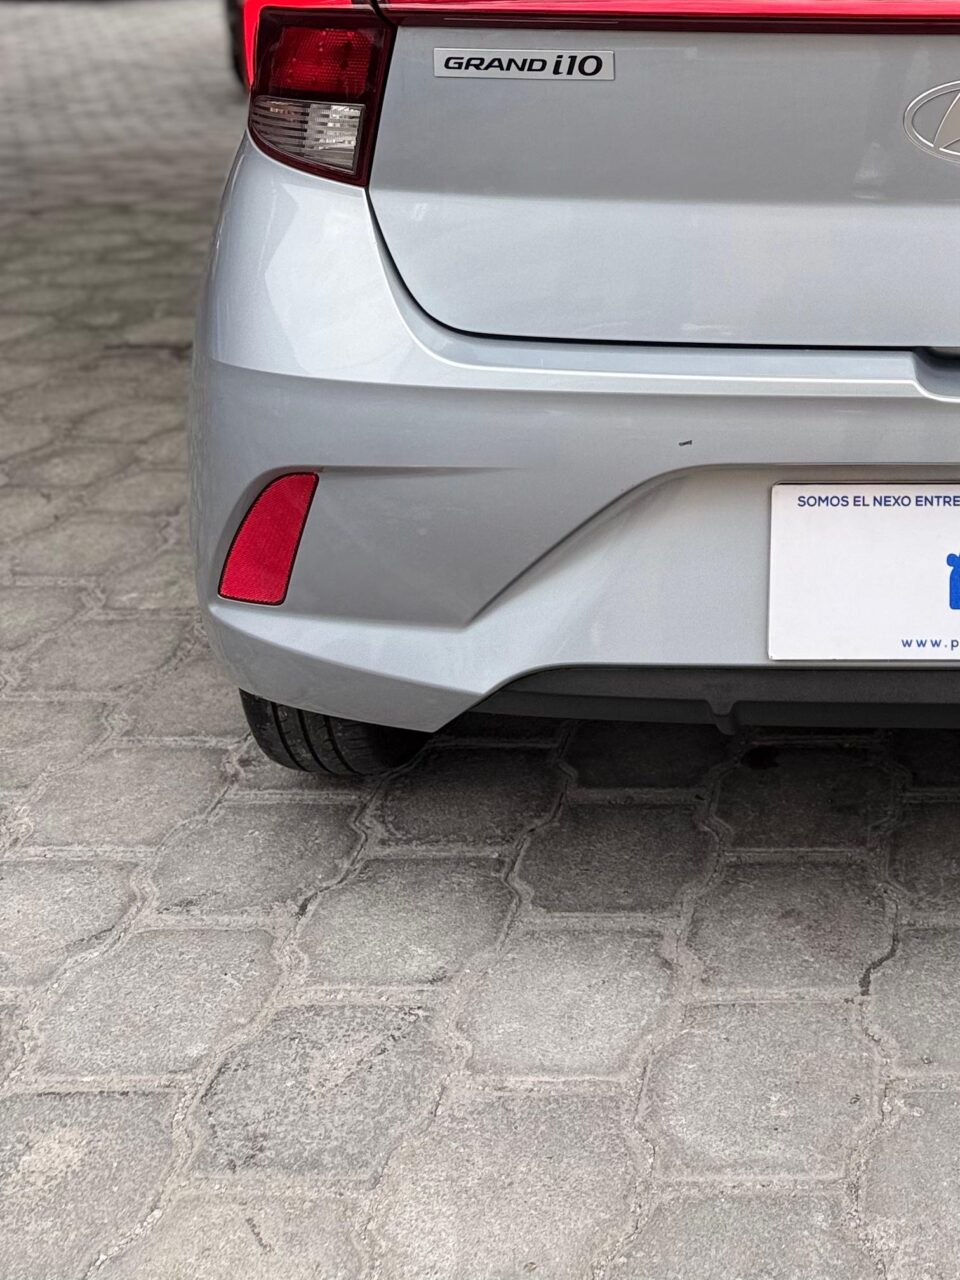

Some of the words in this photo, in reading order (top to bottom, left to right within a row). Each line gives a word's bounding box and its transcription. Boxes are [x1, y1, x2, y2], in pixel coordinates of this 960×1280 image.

[443, 55, 548, 73] GRAND
[552, 53, 604, 77] i10
[797, 495, 850, 508] SOMOS
[852, 495, 870, 508] EL
[872, 495, 912, 508] NEXO
[915, 495, 960, 508] ENTRE
